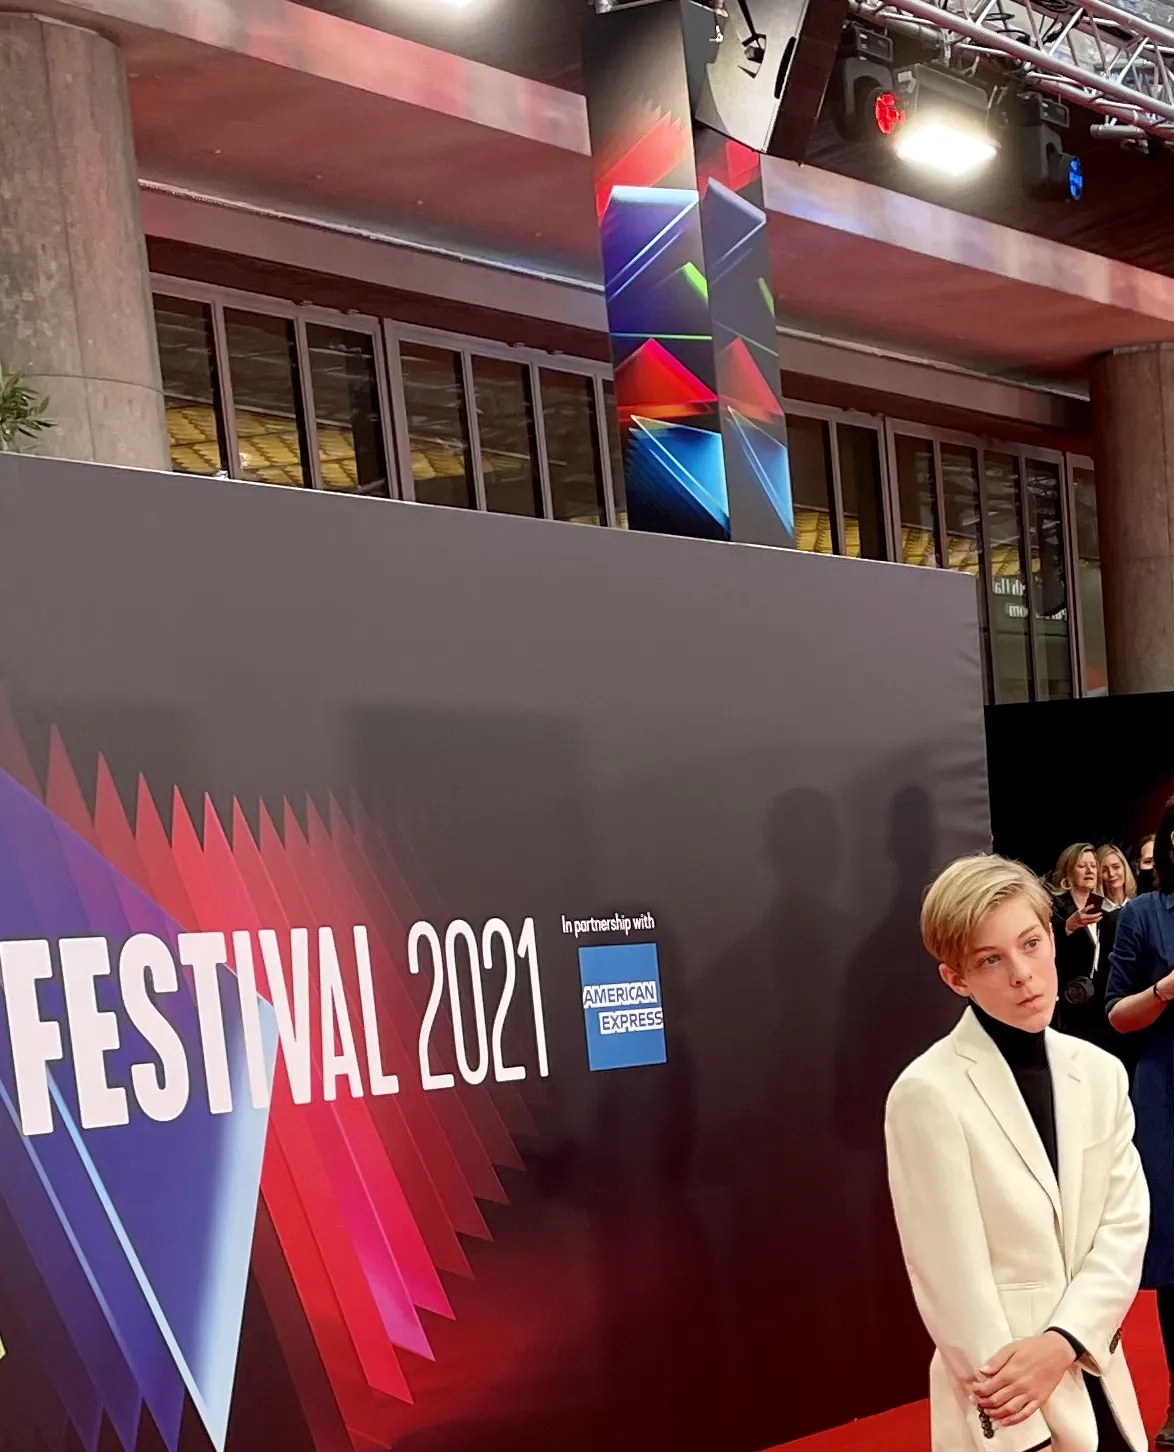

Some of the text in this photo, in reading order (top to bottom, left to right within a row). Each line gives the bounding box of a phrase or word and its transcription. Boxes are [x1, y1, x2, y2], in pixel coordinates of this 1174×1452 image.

[561, 911, 655, 938] In partnership with
[584, 984, 656, 1006] AMERICAN
[0, 917, 549, 1136] FESTIVAL 2021
[601, 1010, 664, 1031] EXPRESS
